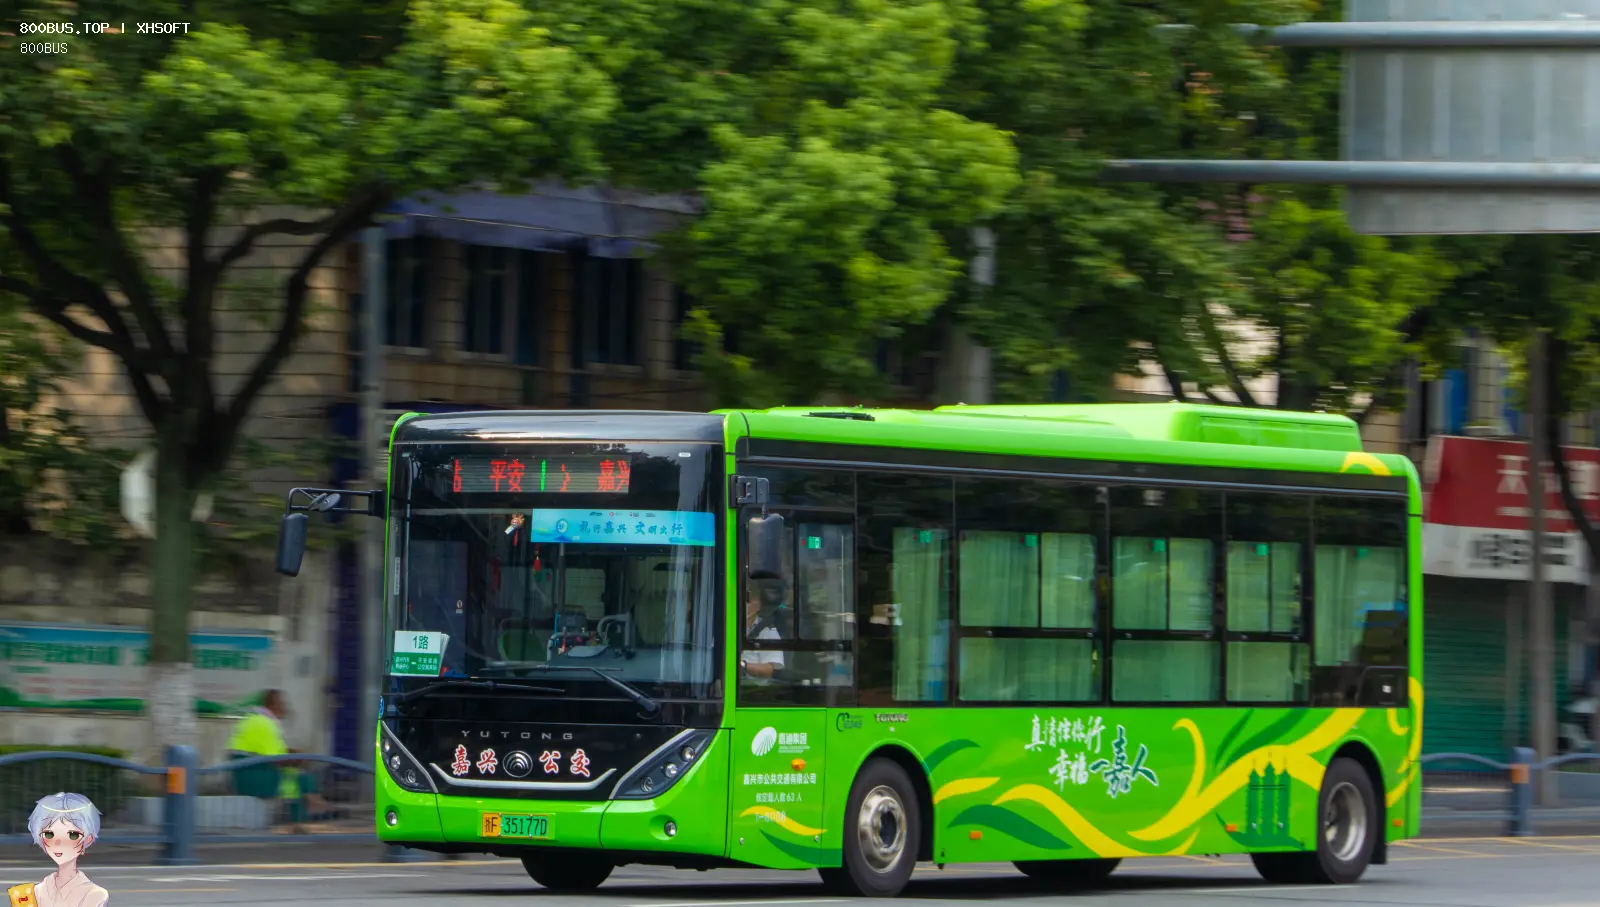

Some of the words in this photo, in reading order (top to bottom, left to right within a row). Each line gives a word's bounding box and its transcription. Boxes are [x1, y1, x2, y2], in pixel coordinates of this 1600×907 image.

[489, 459, 525, 492] 平安
[634, 520, 684, 536] 文明出行
[413, 635, 429, 650] 1路
[461, 730, 573, 740] YUTONG
[451, 744, 499, 776] 嘉兴
[539, 748, 591, 778] 公交
